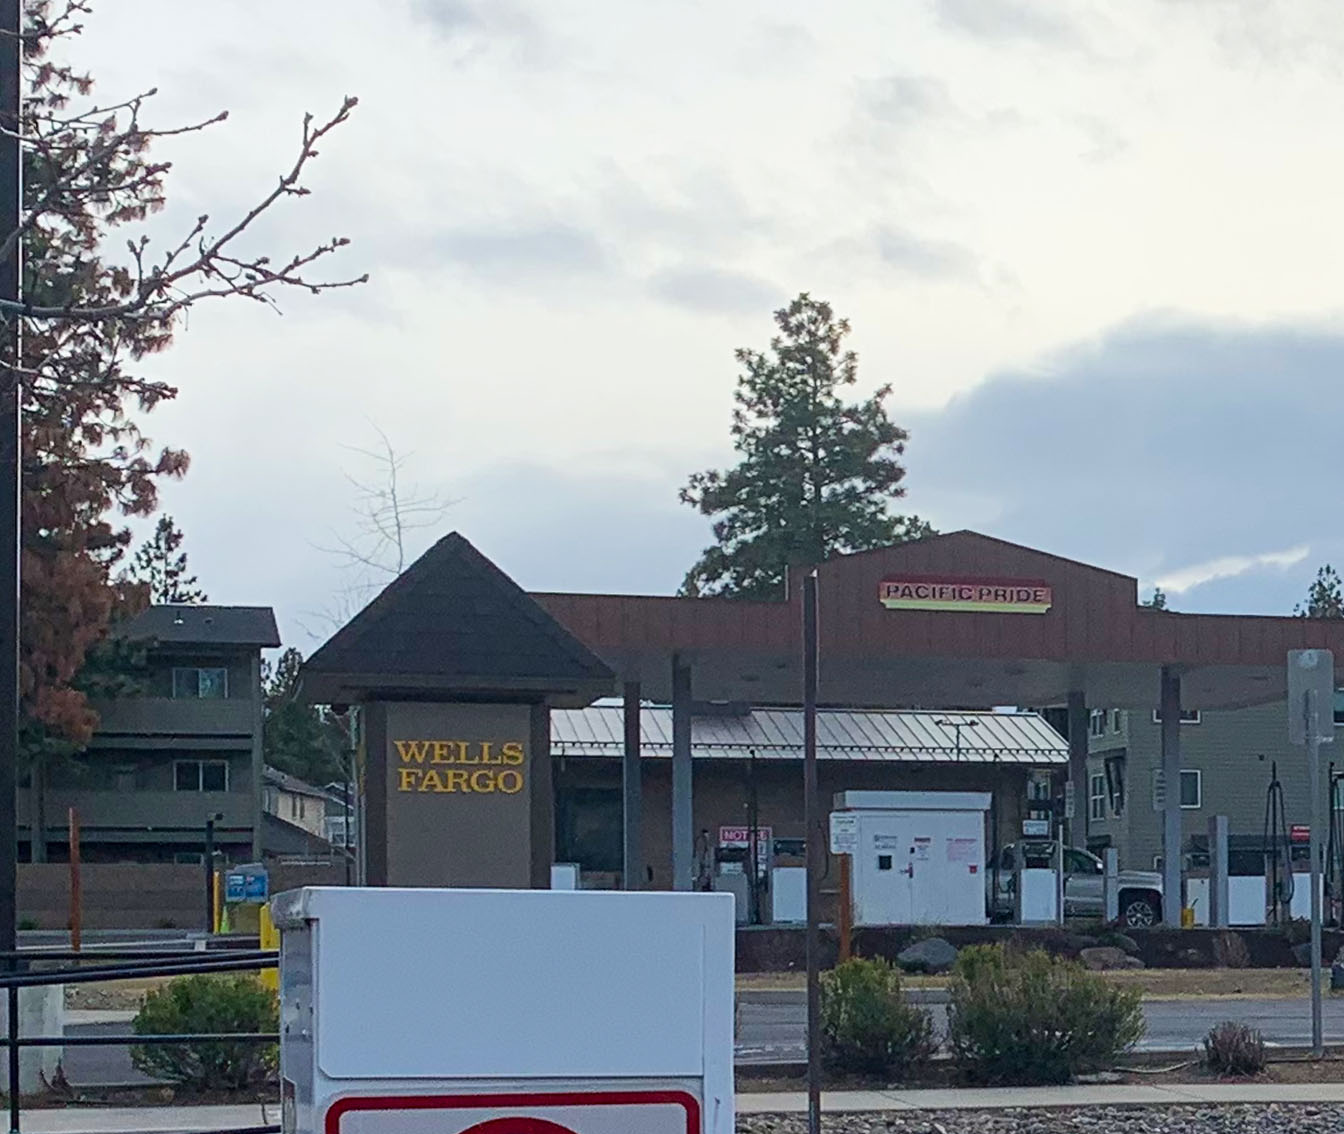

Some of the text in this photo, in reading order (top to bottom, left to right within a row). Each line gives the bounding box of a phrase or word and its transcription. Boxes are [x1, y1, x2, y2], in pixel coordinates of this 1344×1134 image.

[886, 584, 1046, 602] PACIFIC PRIDE
[393, 740, 525, 766] WELLS
[397, 768, 524, 794] FARGO
